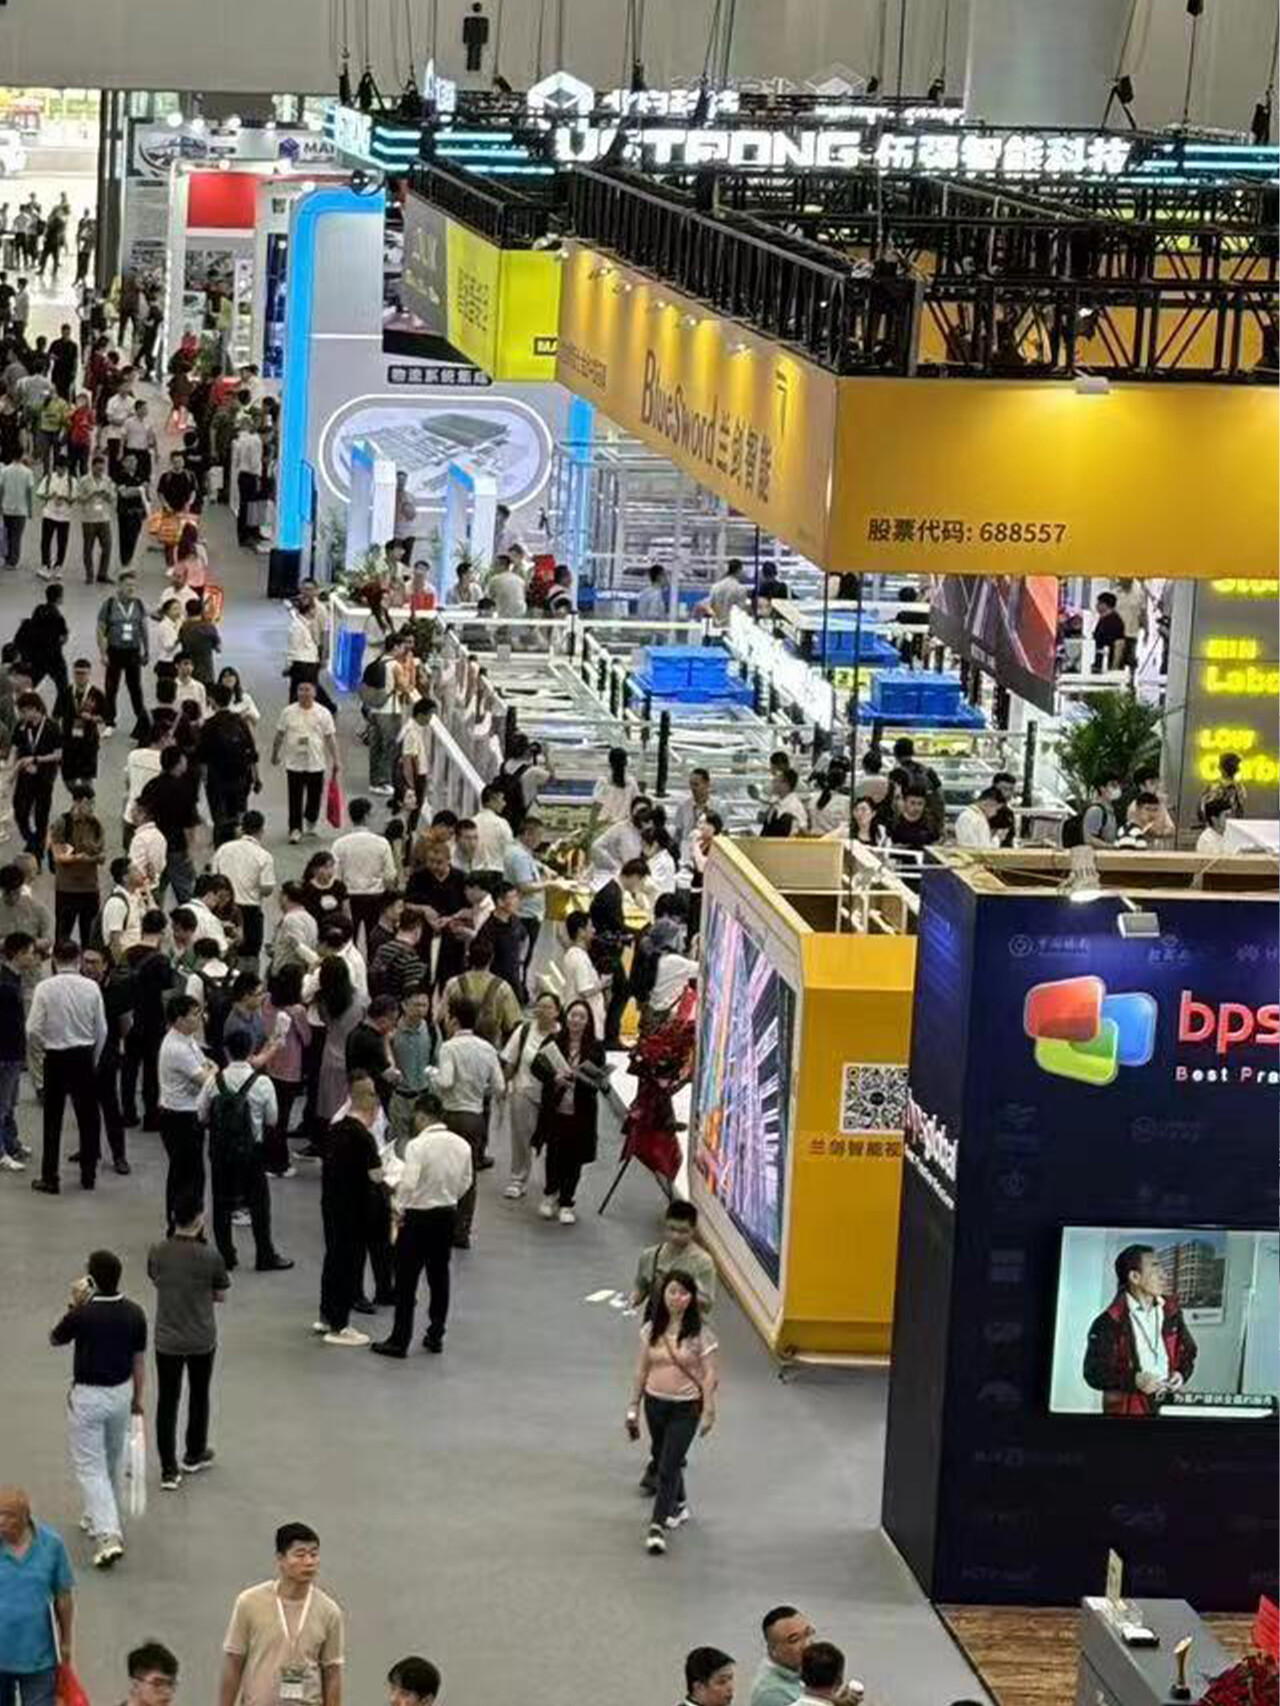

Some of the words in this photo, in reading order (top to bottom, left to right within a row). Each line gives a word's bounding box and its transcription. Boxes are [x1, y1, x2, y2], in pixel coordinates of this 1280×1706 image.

[641, 349, 719, 467] BlueSword
[868, 518, 972, 543] 股票代码:
[979, 521, 1066, 543] 688557
[1178, 989, 1280, 1053] bps
[1176, 1066, 1229, 1082] Best
